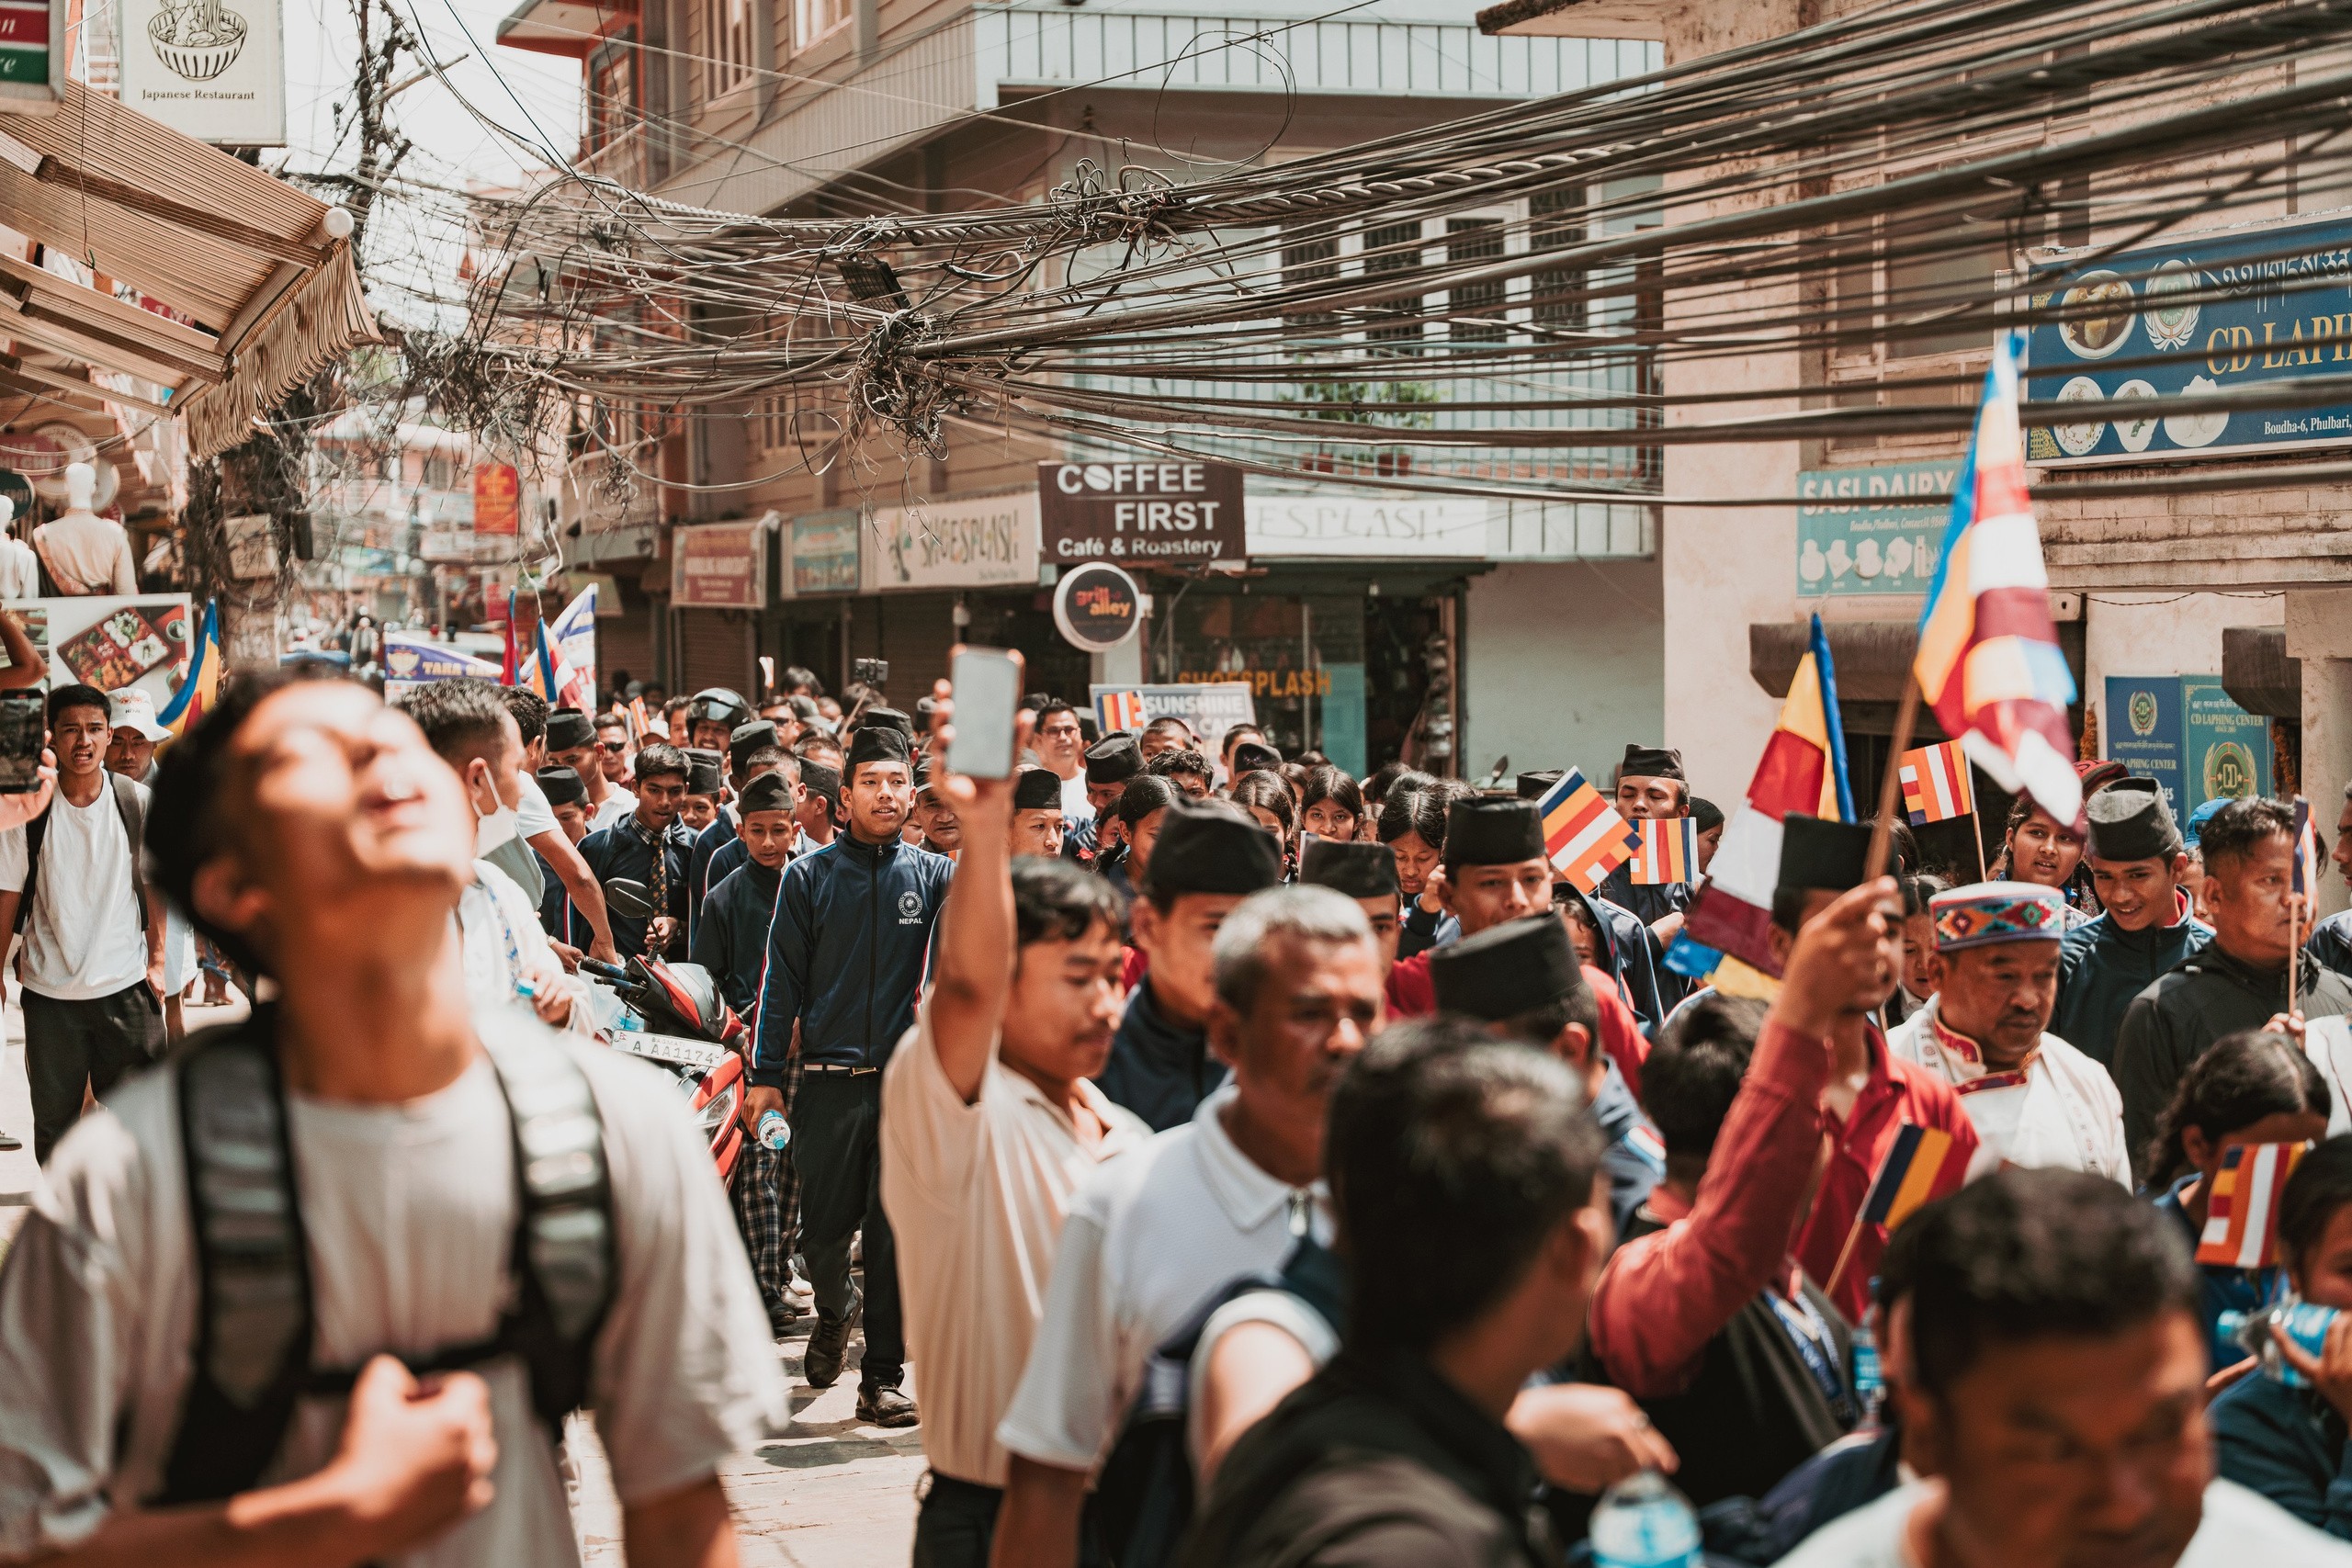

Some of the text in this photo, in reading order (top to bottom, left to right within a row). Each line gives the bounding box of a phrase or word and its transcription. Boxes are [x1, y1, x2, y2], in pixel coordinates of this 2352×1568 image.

[141, 89, 255, 101] Japanese Restaurant
[2207, 325, 2254, 376] CD
[2264, 413, 2352, 436] Boudha-6, Phulbari,
[1057, 464, 1206, 494] COFFEE
[1803, 470, 1954, 516] SASI DAIRY
[1114, 501, 1220, 532] FIRST
[1057, 536, 1223, 558] Café & Roastery
[1090, 599, 1131, 618] alley
[423, 661, 462, 675] TARA
[1146, 695, 1246, 716] SUNSHINE
[2190, 713, 2264, 727] CD LAPHING CENTER
[2151, 759, 2177, 771] CENTER
[632, 1040, 641, 1052] A
